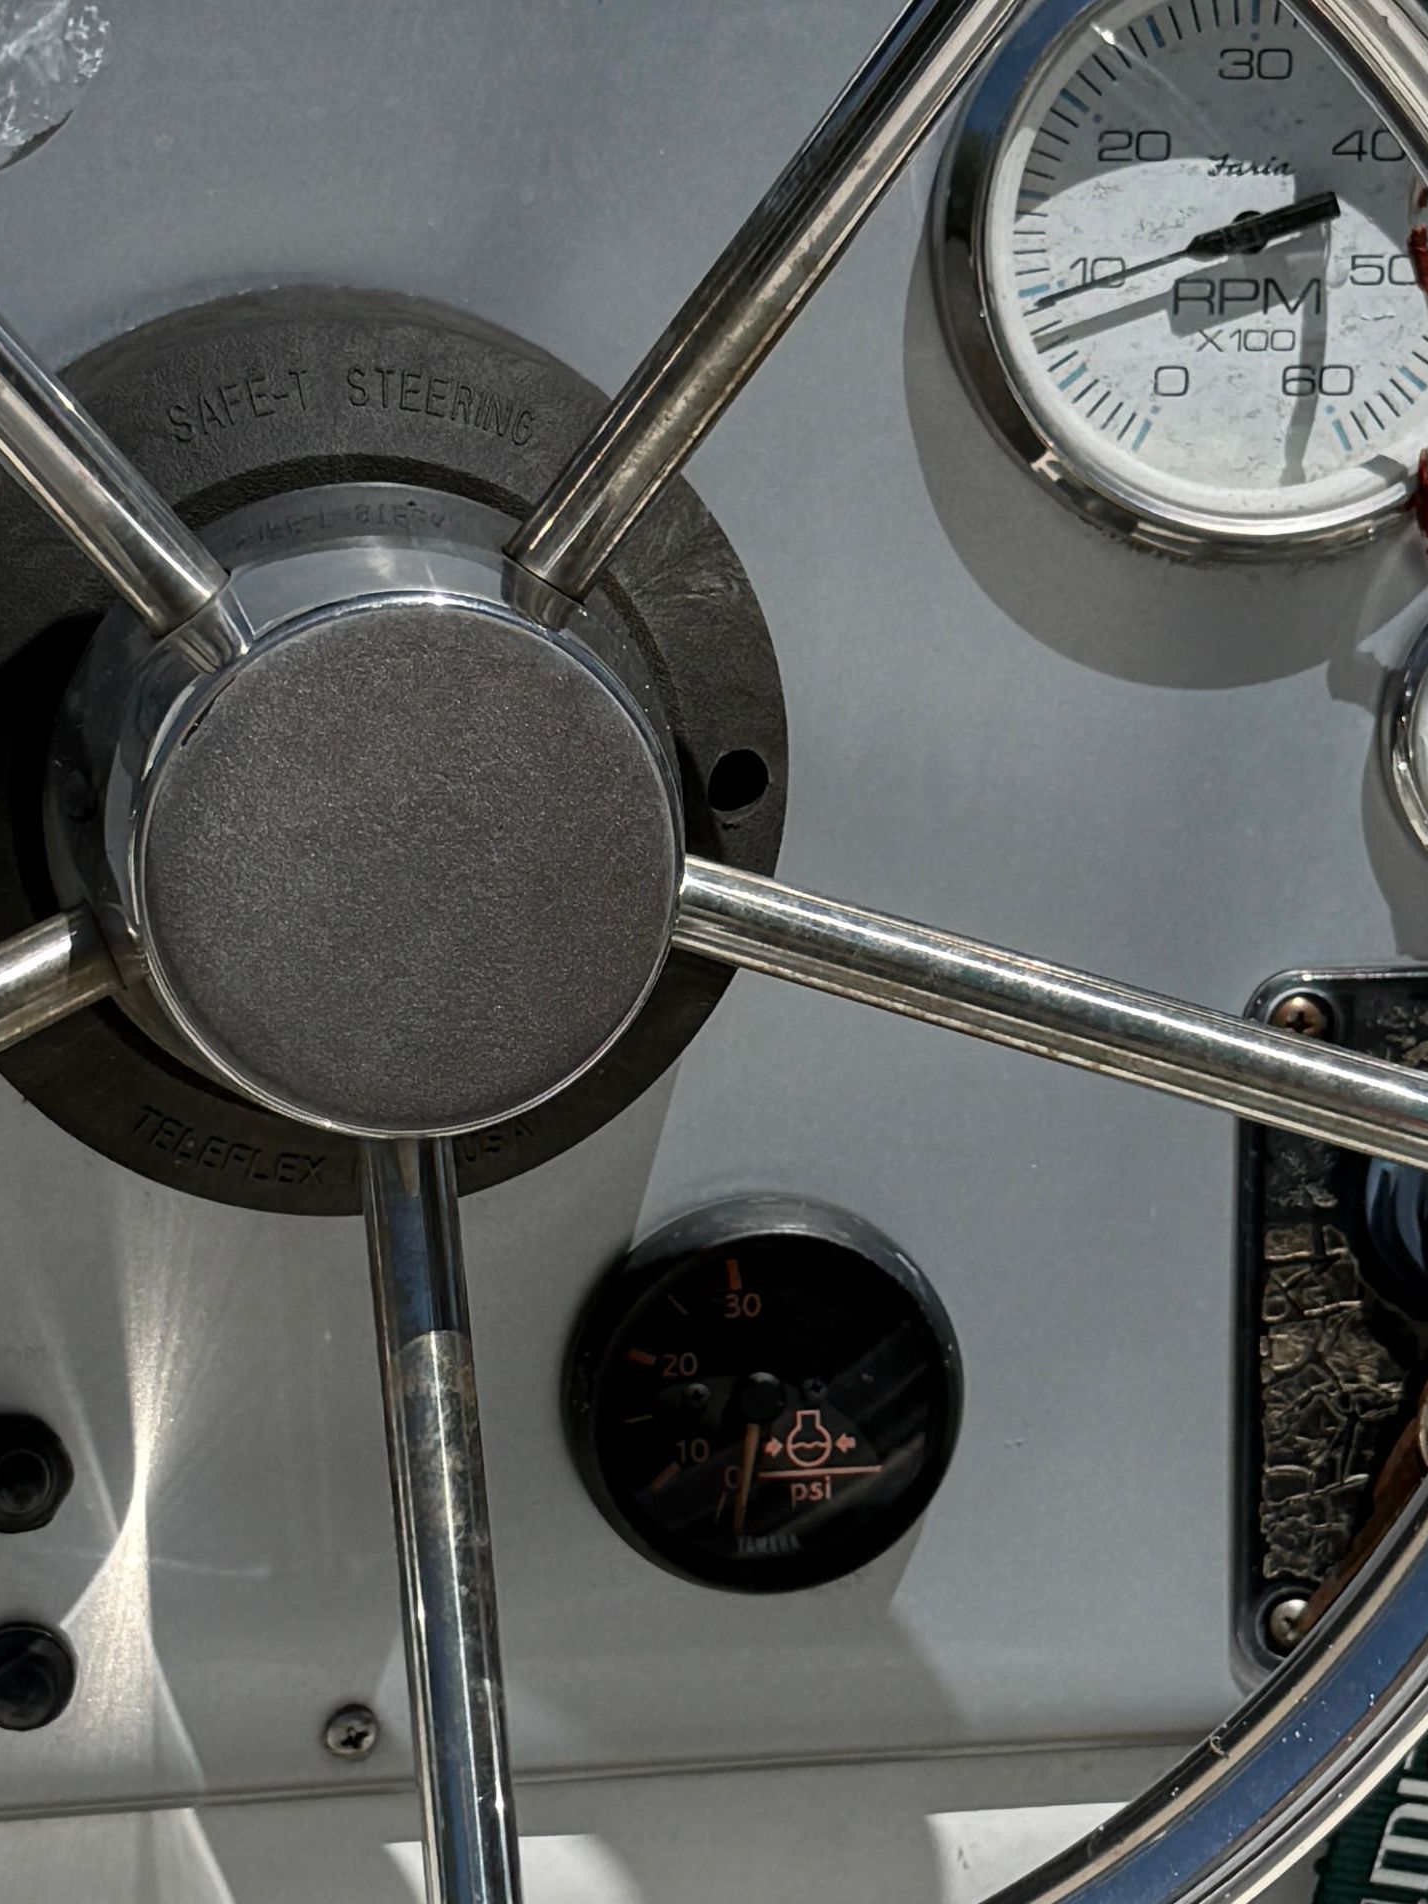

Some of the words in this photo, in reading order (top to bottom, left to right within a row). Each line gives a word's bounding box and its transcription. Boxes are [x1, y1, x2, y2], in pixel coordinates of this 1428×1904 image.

[1217, 47, 1294, 82] 30
[1097, 129, 1172, 162] 20
[1332, 129, 1406, 163] 40
[1206, 152, 1296, 178] Faria
[1068, 256, 1128, 290] 10
[1349, 254, 1417, 287] 50
[1172, 277, 1322, 316] RPM
[1151, 365, 1189, 397] 0
[1281, 364, 1355, 397] 60
[167, 368, 308, 444] SAFE-T
[345, 365, 536, 447] STEERING
[128, 1104, 329, 1187] TELEFLEX
[723, 1292, 763, 1319] 30
[661, 1351, 699, 1378] 20
[676, 1438, 710, 1465] 10
[789, 1475, 832, 1509] psi
